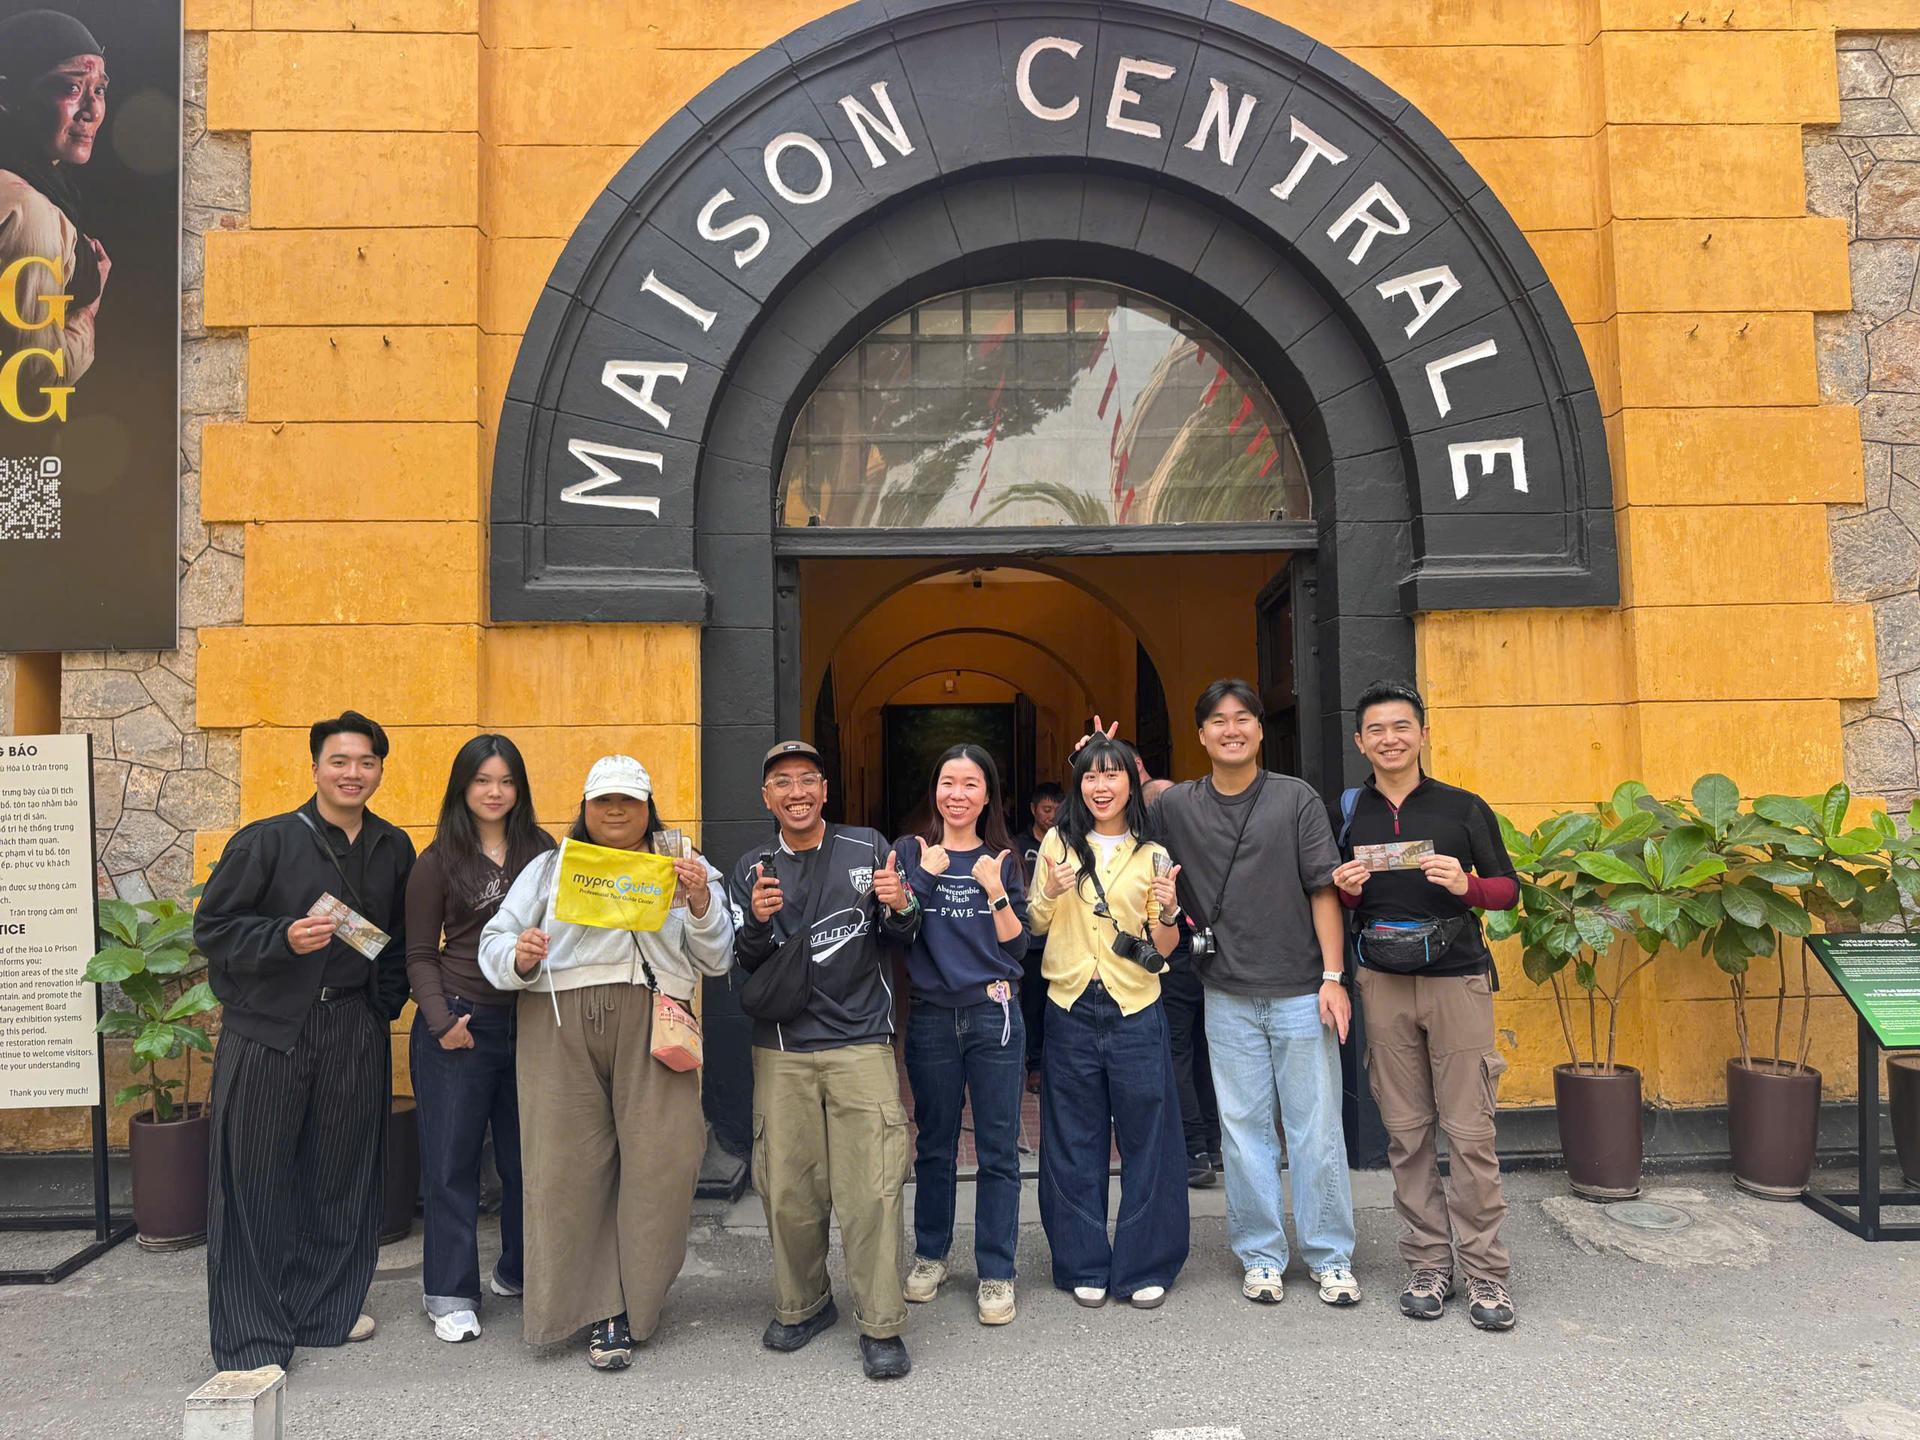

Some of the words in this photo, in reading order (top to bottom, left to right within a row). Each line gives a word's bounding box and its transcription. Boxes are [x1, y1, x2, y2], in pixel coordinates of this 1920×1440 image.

[560, 81, 915, 519] MAISON
[1016, 37, 1529, 500] CENTRALE
[0, 256, 74, 330] G
[0, 348, 75, 422] G
[9, 743, 37, 756] BÁO
[573, 874, 663, 896] myproGuide
[936, 884, 980, 896] Abercrombie
[952, 894, 970, 903] Fitch
[950, 908, 974, 918] AVE
[38, 992, 68, 1000] promote
[46, 1002, 66, 1010] Board
[16, 1014, 52, 1023] exhibition
[54, 1014, 82, 1022] systems
[22, 1026, 47, 1035] period.
[6, 1038, 46, 1046] restoration
[48, 1037, 72, 1045] remain
[10, 1063, 26, 1071] your
[28, 1061, 80, 1069] understanding
[33, 1090, 47, 1098] you
[48, 1088, 64, 1096] very
